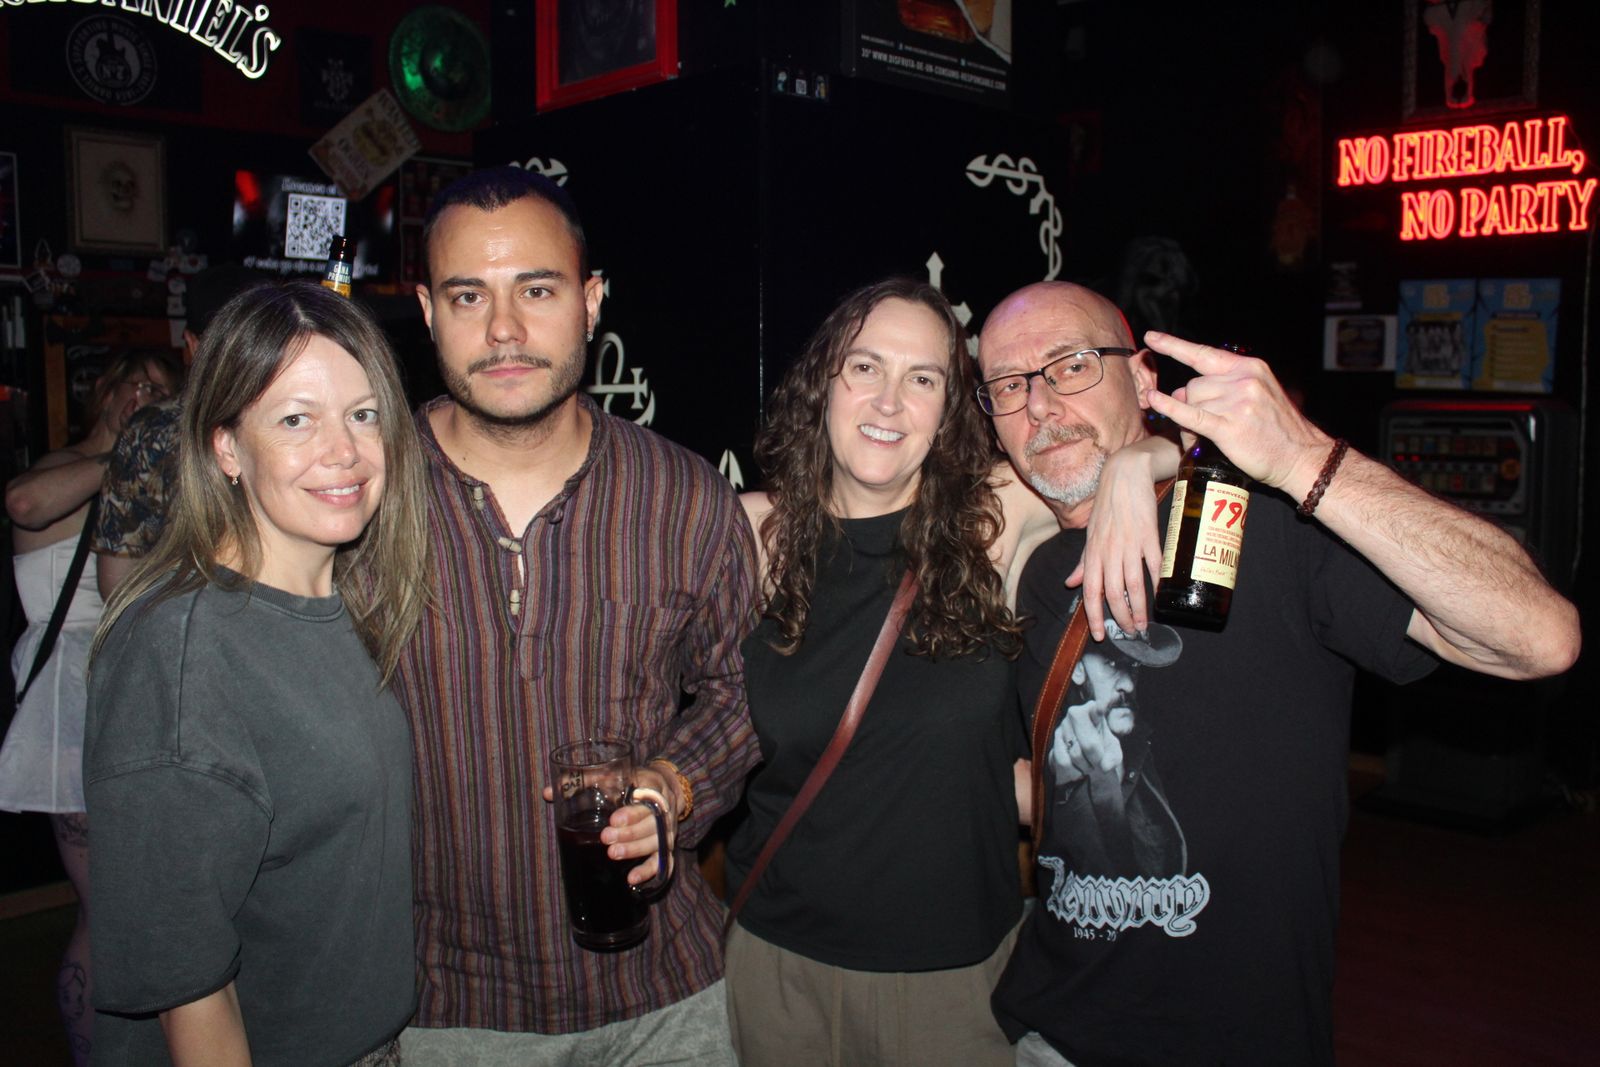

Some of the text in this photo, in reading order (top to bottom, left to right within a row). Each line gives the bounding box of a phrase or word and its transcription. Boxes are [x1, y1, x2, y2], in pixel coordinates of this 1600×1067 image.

[1337, 116, 1585, 187] NO FIREBALL,
[1400, 178, 1598, 241] NO PARTY
[1203, 544, 1217, 557] LA
[1072, 926, 1096, 941] 1945
